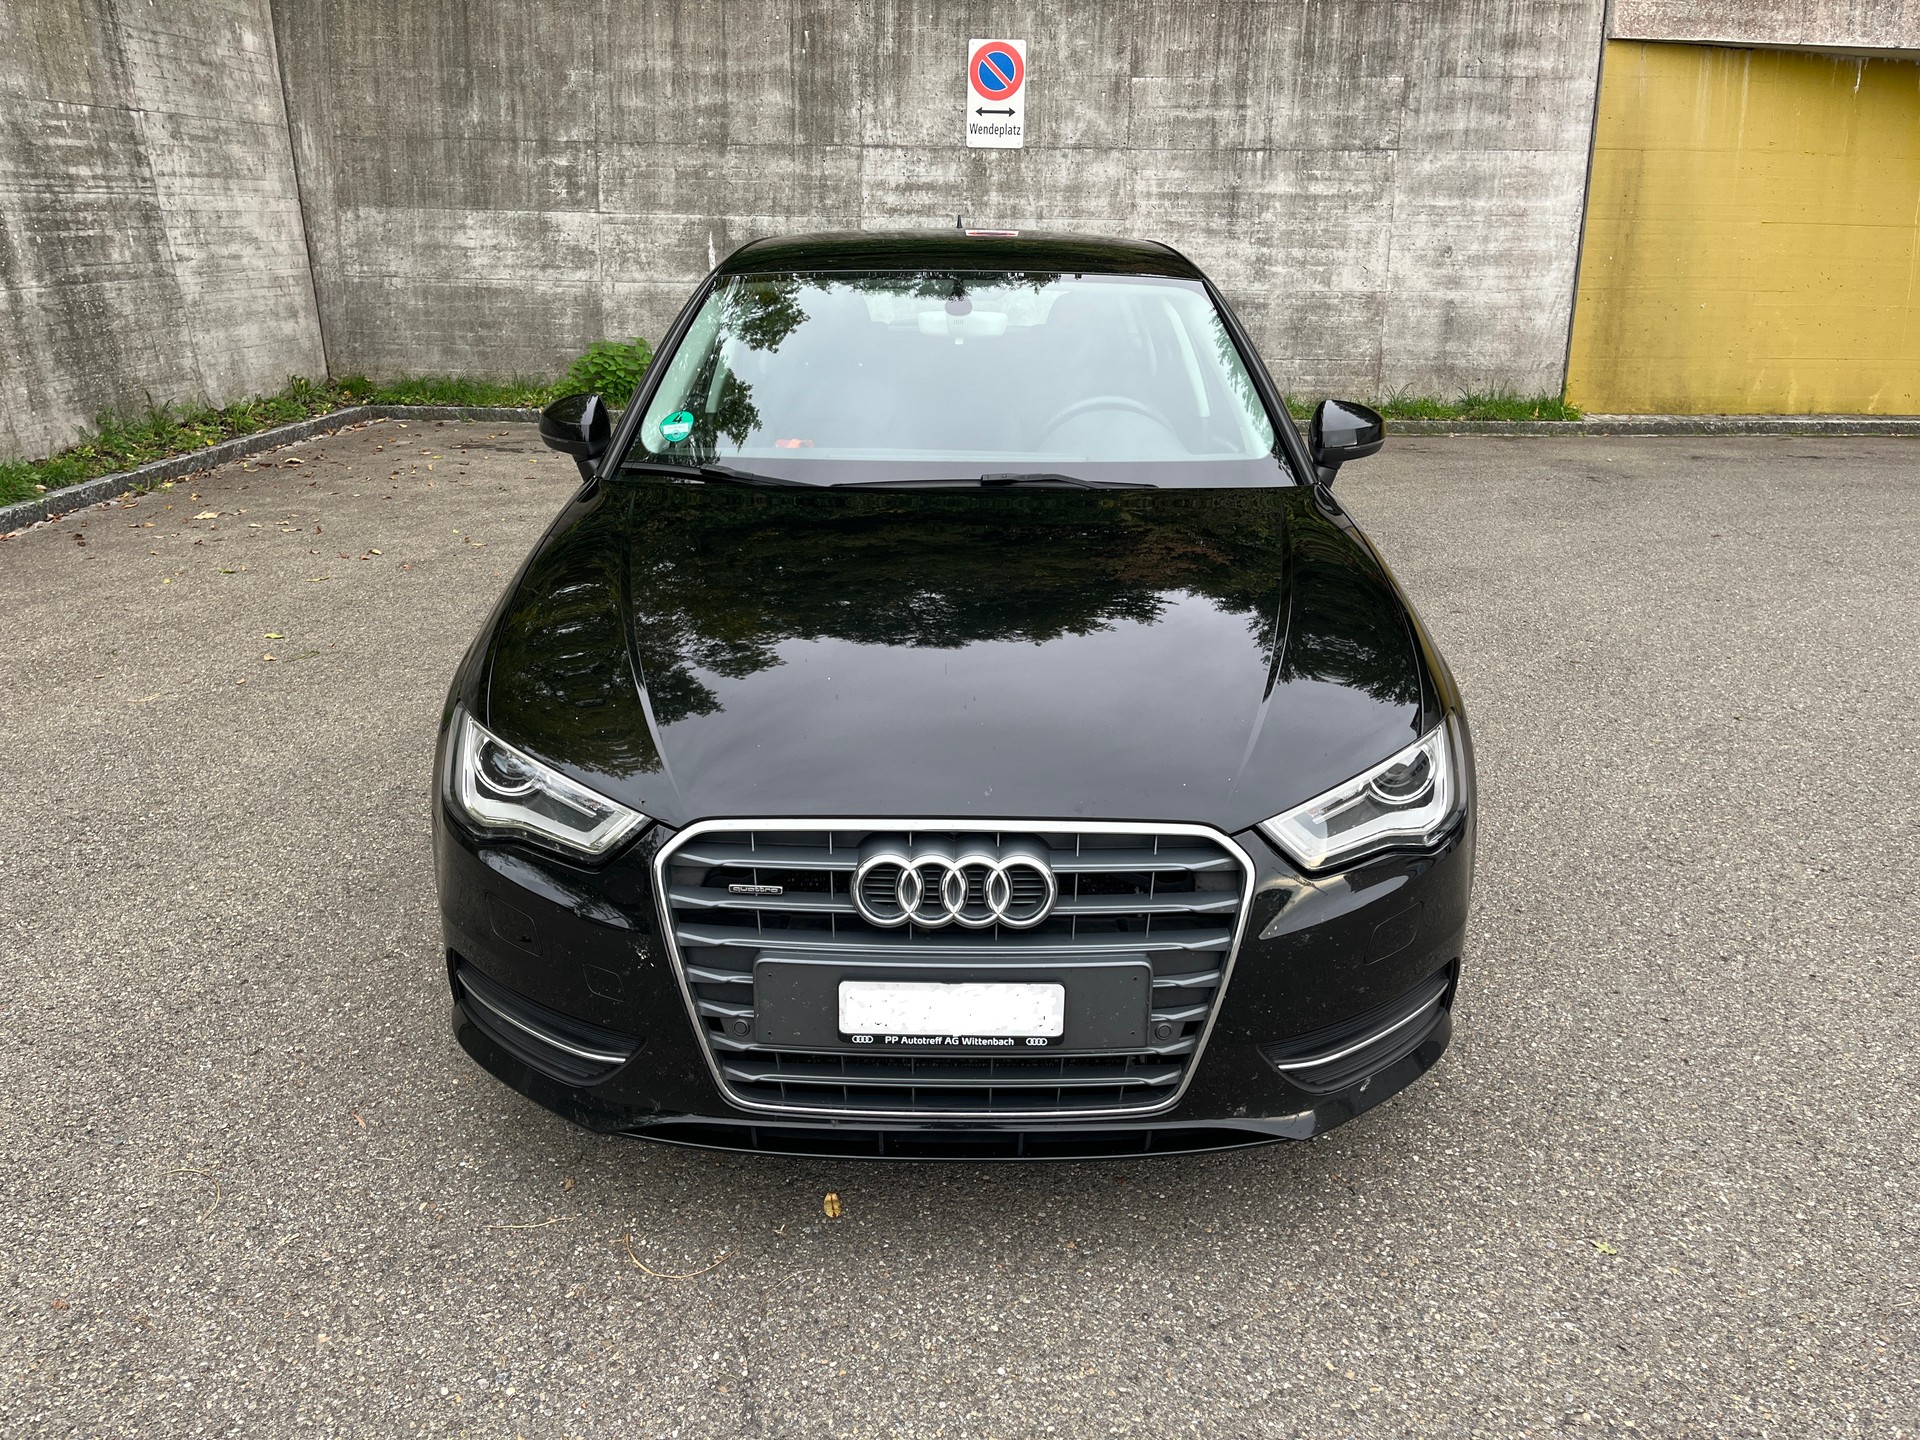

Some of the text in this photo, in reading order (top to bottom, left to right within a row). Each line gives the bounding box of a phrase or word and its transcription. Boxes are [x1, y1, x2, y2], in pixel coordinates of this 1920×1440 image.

[969, 123, 1021, 138] Wendeplatz
[672, 412, 683, 424] 4
[732, 885, 779, 894] quattro
[884, 1035, 1015, 1046] PP Autotreff AG Wittenbach
